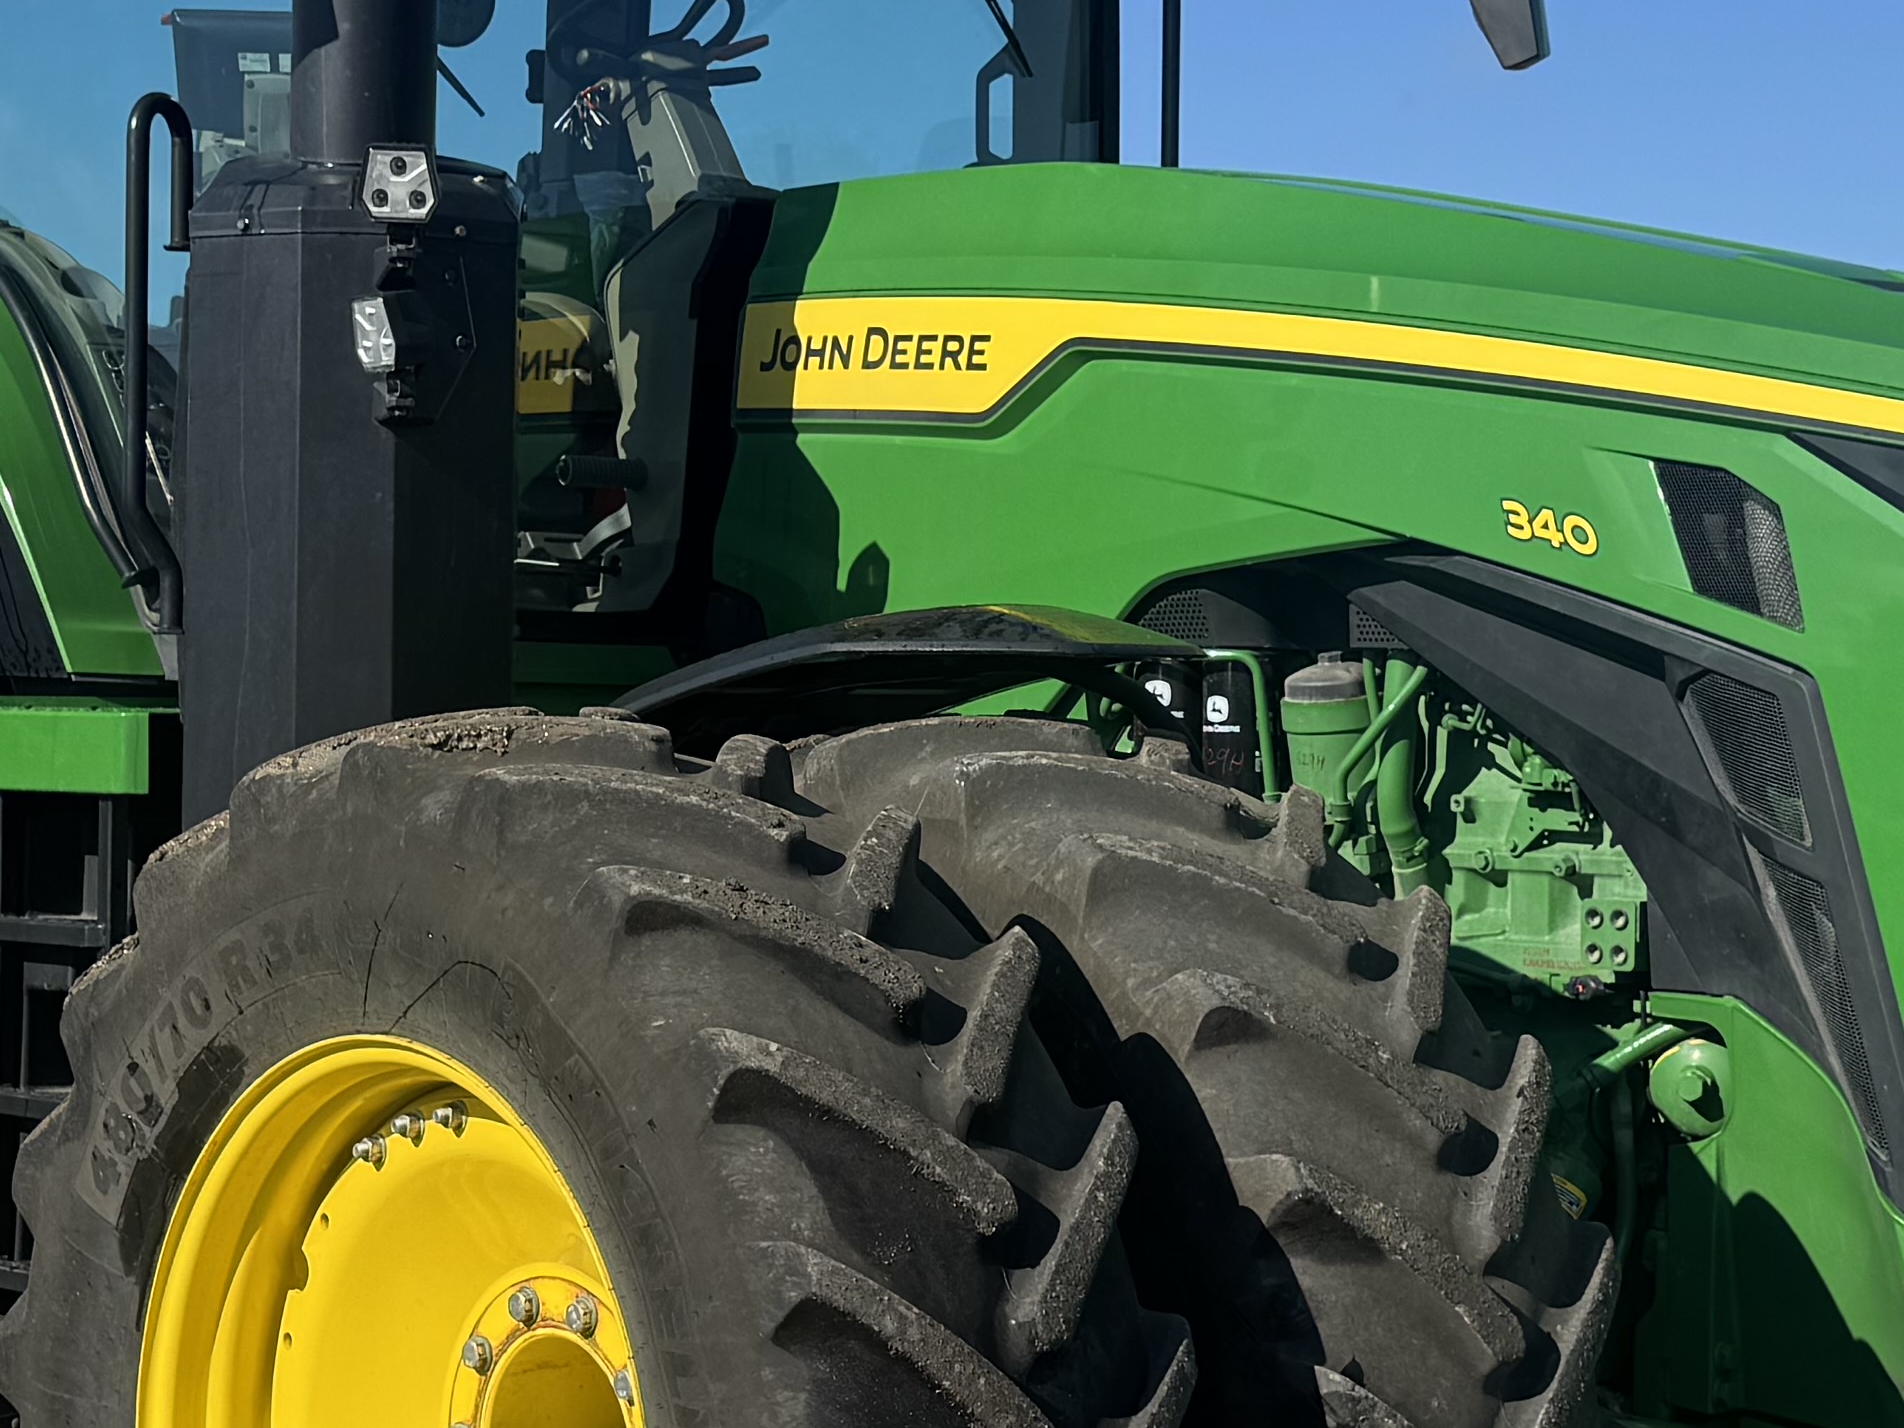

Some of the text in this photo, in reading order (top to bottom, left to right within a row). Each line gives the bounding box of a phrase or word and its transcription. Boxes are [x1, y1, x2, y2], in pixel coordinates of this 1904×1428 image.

[760, 327, 991, 371] JOHN DEERE
[1501, 499, 1598, 555] 340
